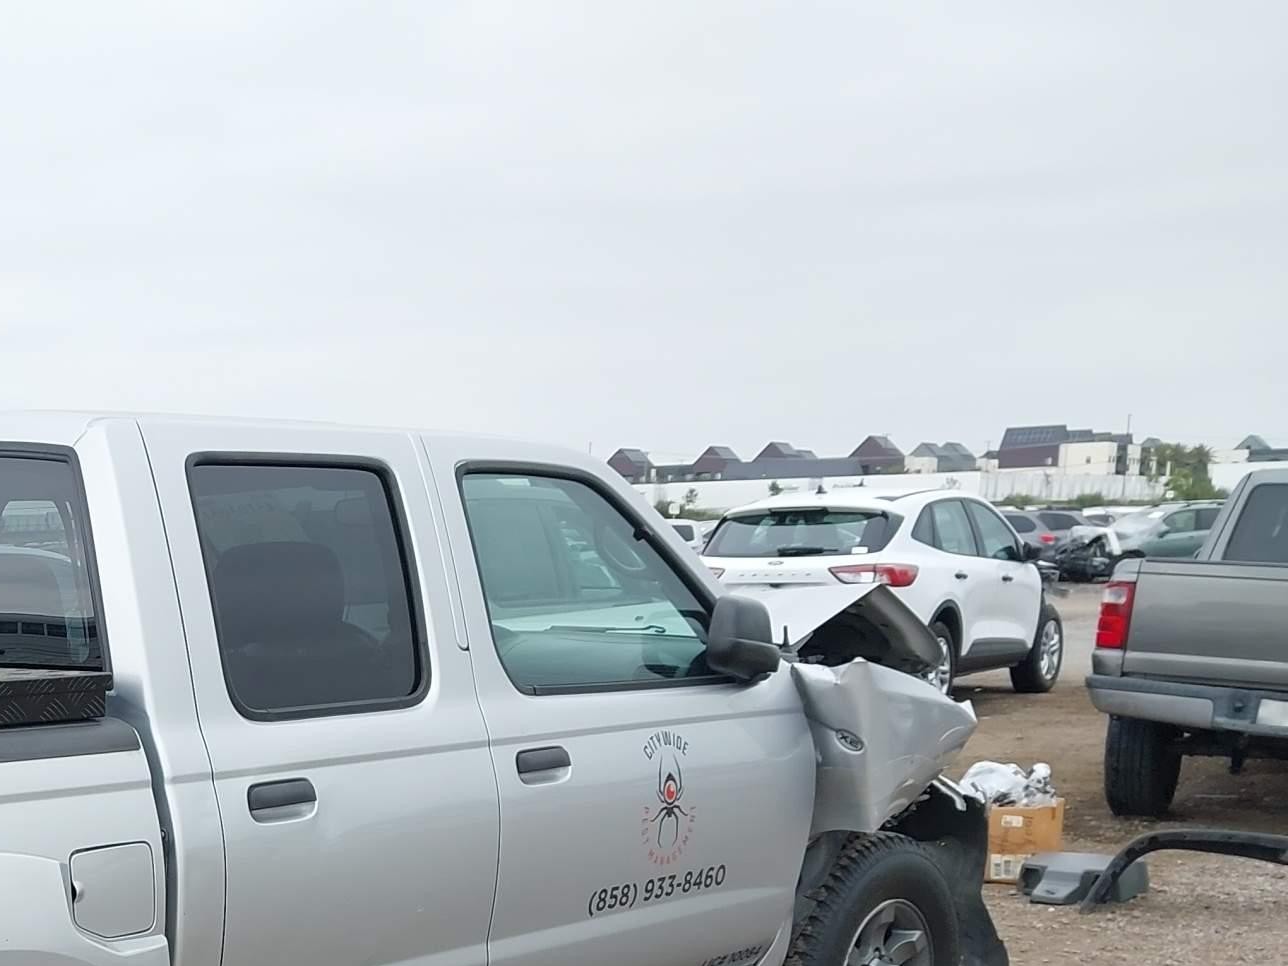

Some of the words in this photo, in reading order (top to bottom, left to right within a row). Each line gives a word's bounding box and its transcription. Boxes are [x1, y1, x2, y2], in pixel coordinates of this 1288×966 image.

[643, 729, 689, 761] CITYWIDE
[588, 882, 638, 917] (858)
[643, 863, 727, 903] 933-8460
